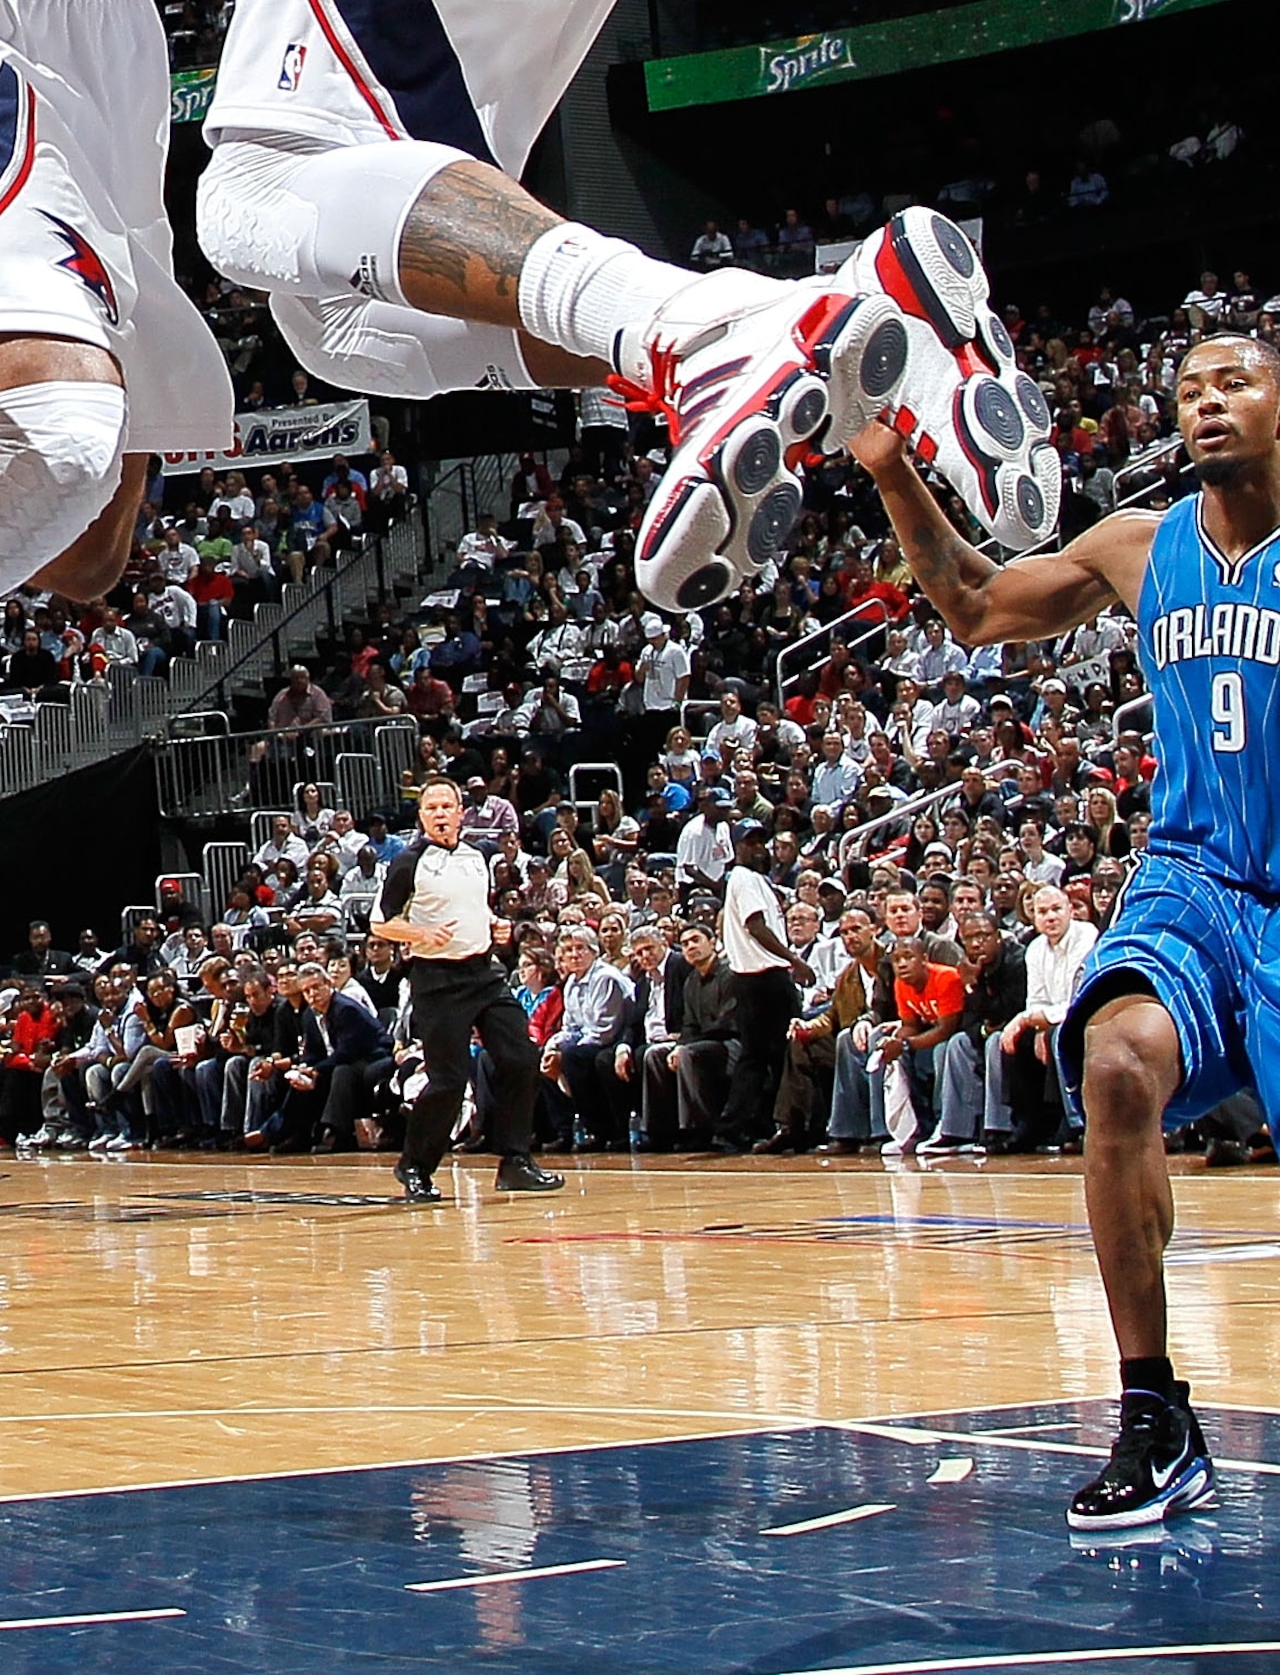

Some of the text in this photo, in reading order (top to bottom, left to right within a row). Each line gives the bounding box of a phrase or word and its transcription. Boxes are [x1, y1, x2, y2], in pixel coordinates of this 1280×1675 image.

[767, 32, 841, 92] Sprite
[272, 415, 319, 427] Presented
[1211, 671, 1248, 753] 9
